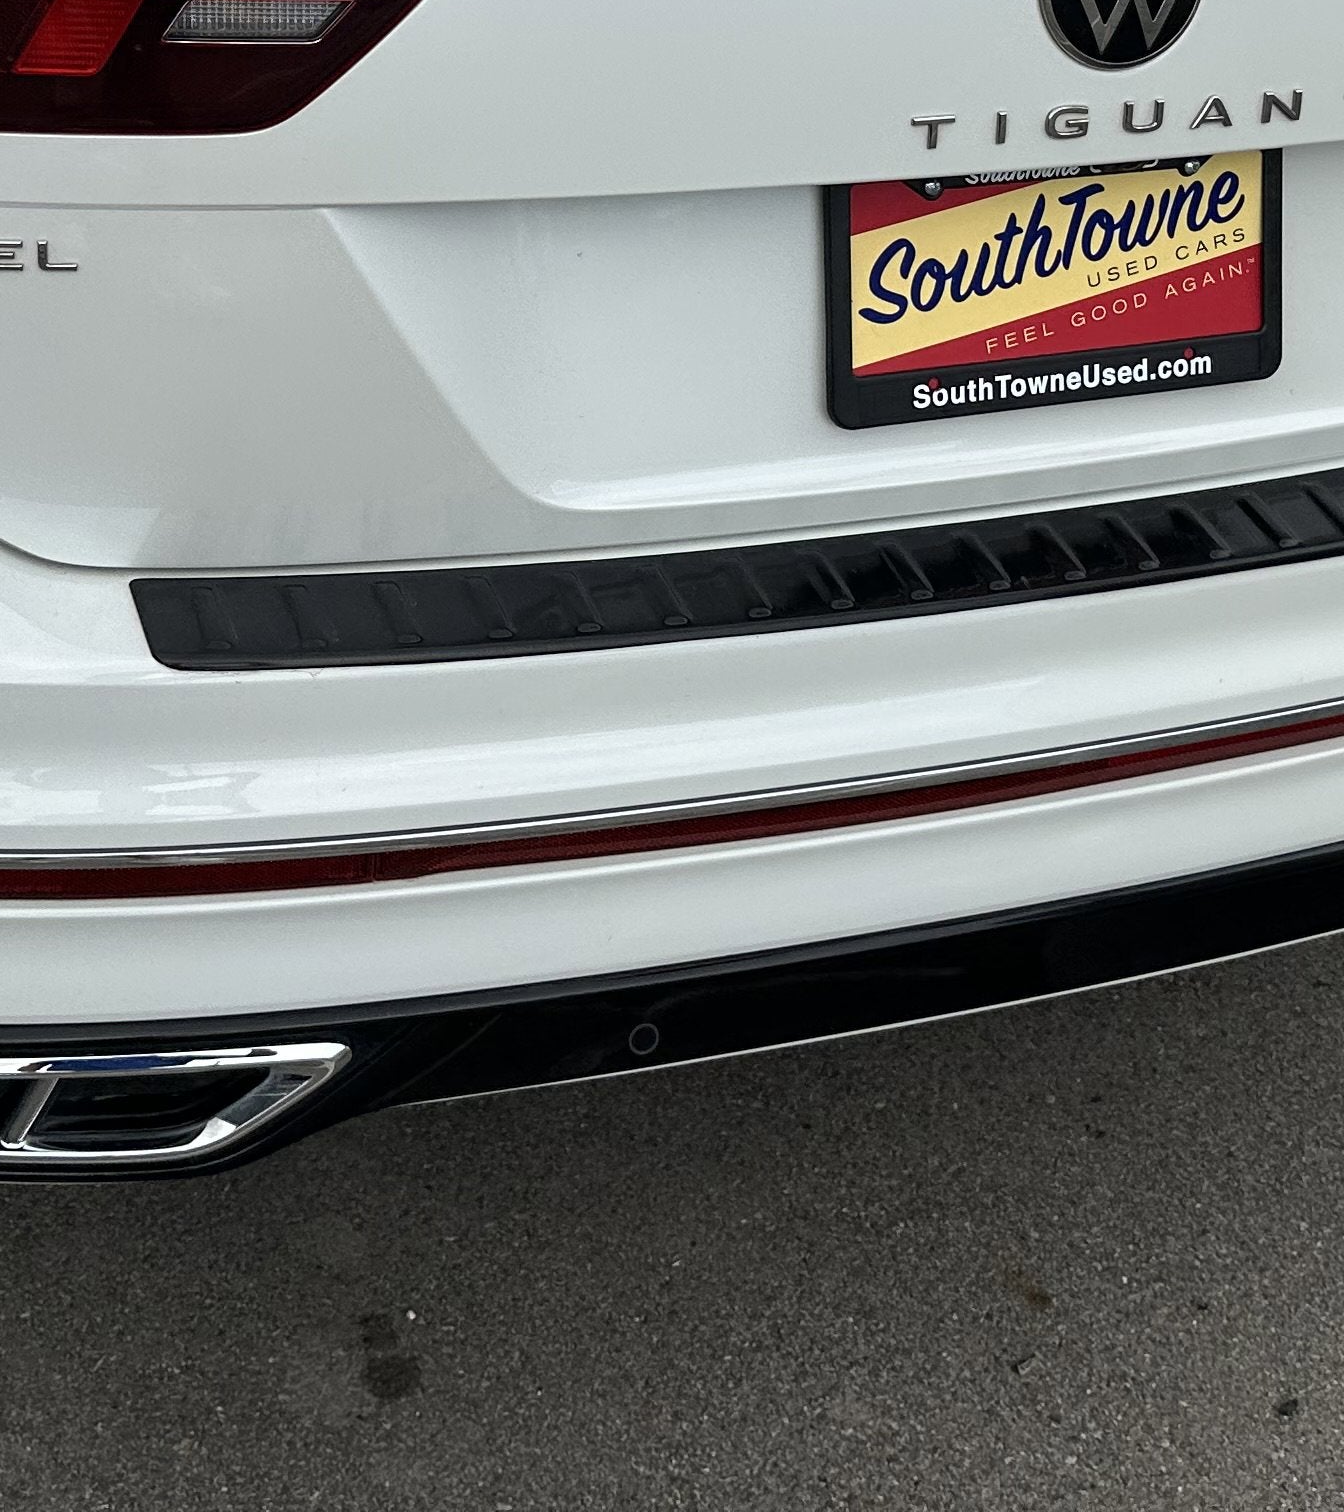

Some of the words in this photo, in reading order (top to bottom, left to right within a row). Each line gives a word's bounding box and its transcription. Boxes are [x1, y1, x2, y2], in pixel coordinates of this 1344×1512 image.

[911, 89, 1303, 149] TIGUAN
[859, 171, 1245, 324] SouthTowne
[1087, 256, 1158, 287] USED
[1175, 228, 1245, 260] CARS
[986, 322, 1054, 354] FEEL
[1071, 293, 1147, 327] GOOD
[913, 353, 1212, 409] SouthTowneUsed.com
